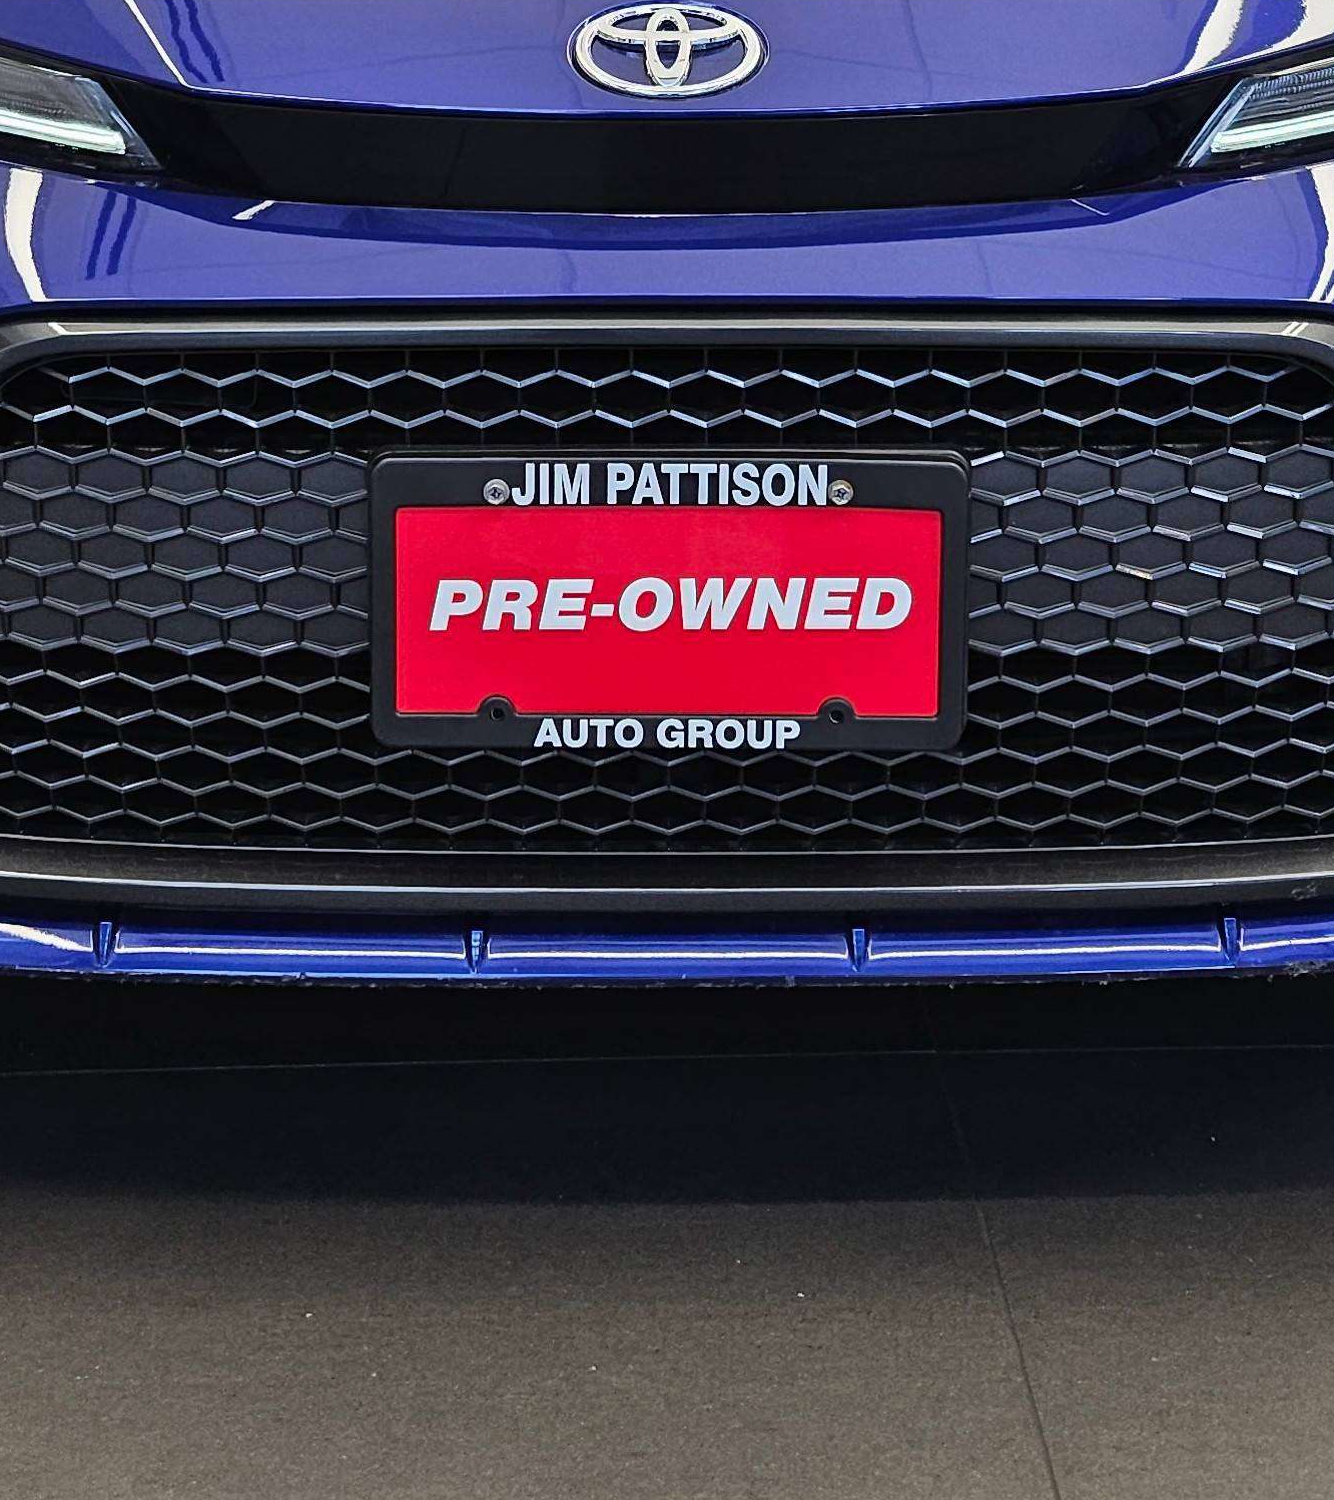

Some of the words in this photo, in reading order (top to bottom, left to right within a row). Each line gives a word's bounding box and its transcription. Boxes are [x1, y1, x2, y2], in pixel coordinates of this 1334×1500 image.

[511, 463, 590, 506] JIM
[606, 463, 828, 506] PATTISON
[429, 577, 912, 631] PRE-OWNED
[533, 719, 644, 749] AUTO
[656, 719, 801, 749] GROUP
